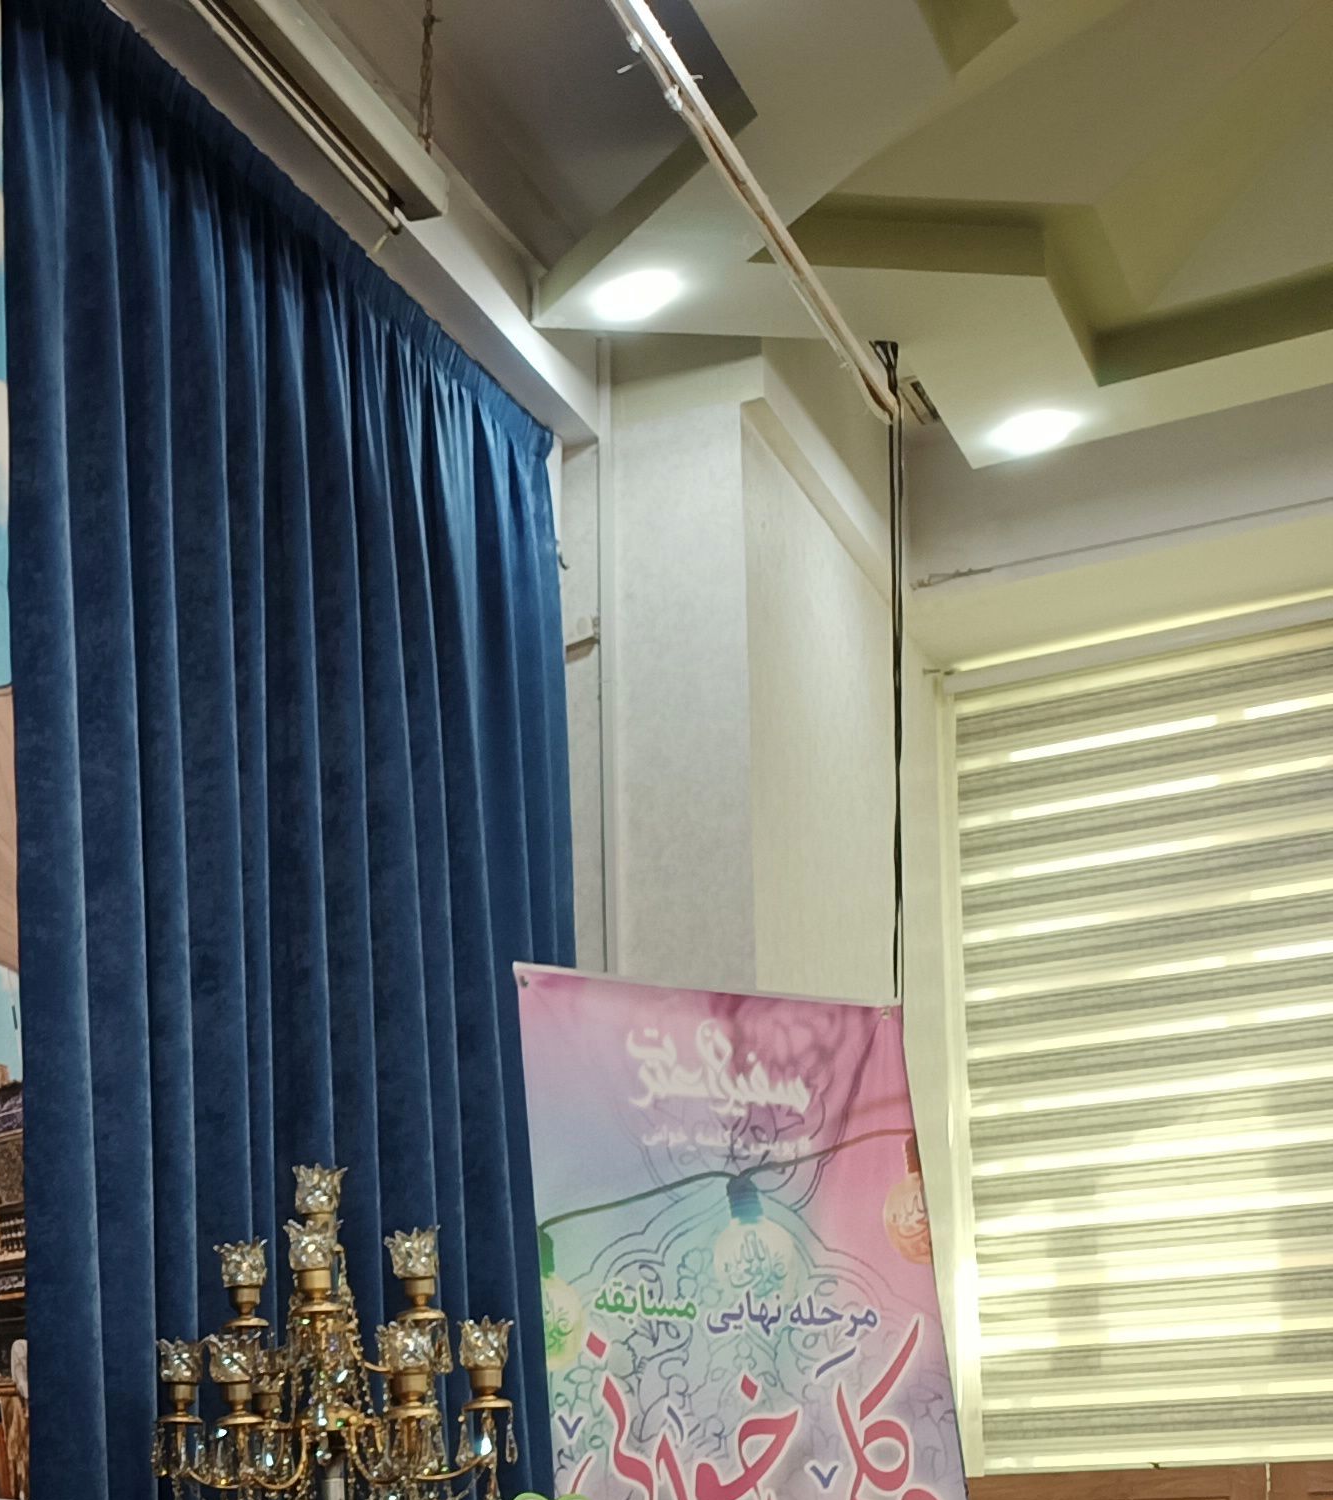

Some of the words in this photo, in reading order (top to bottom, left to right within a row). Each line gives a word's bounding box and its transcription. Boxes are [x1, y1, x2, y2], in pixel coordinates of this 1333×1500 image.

[593, 1280, 698, 1325] مسابقه
[707, 1290, 782, 1334] نهایی
[790, 1296, 879, 1339] مرحله
